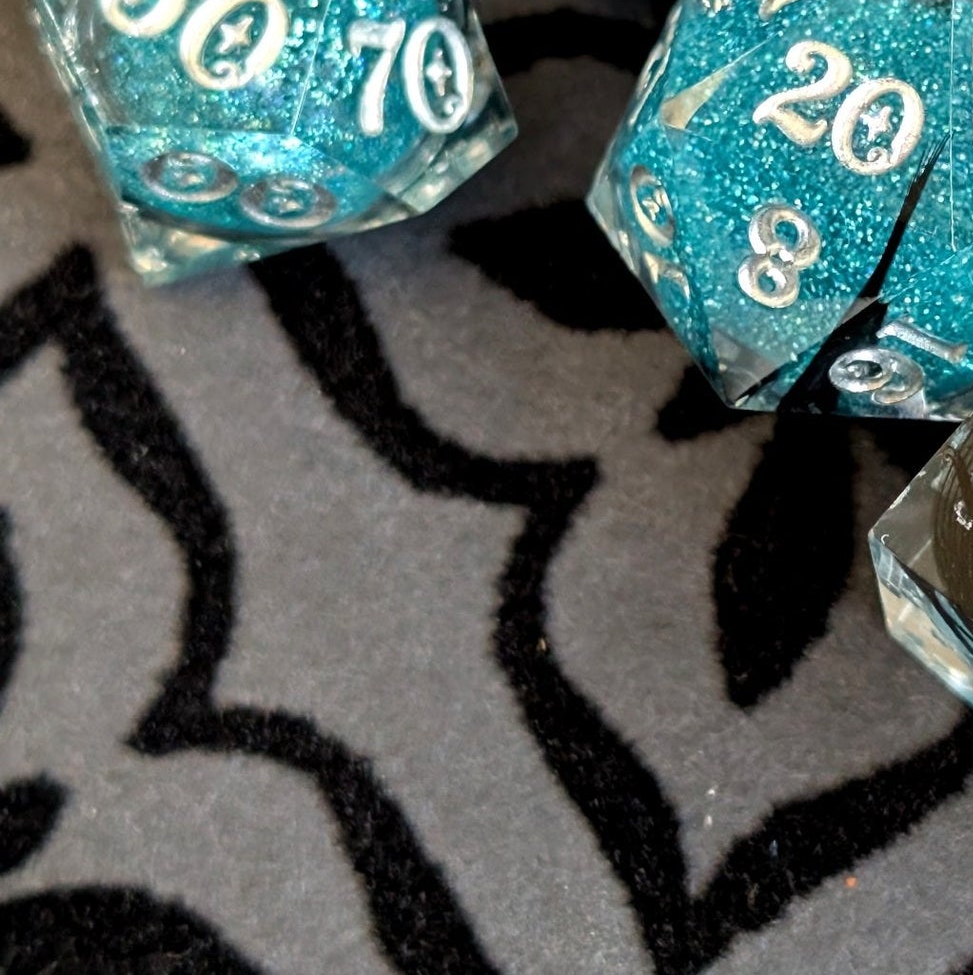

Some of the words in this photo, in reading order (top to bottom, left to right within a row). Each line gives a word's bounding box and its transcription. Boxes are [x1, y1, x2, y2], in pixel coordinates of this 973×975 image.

[348, 16, 475, 137] 70
[752, 40, 926, 177] 20
[738, 202, 821, 309] 8
